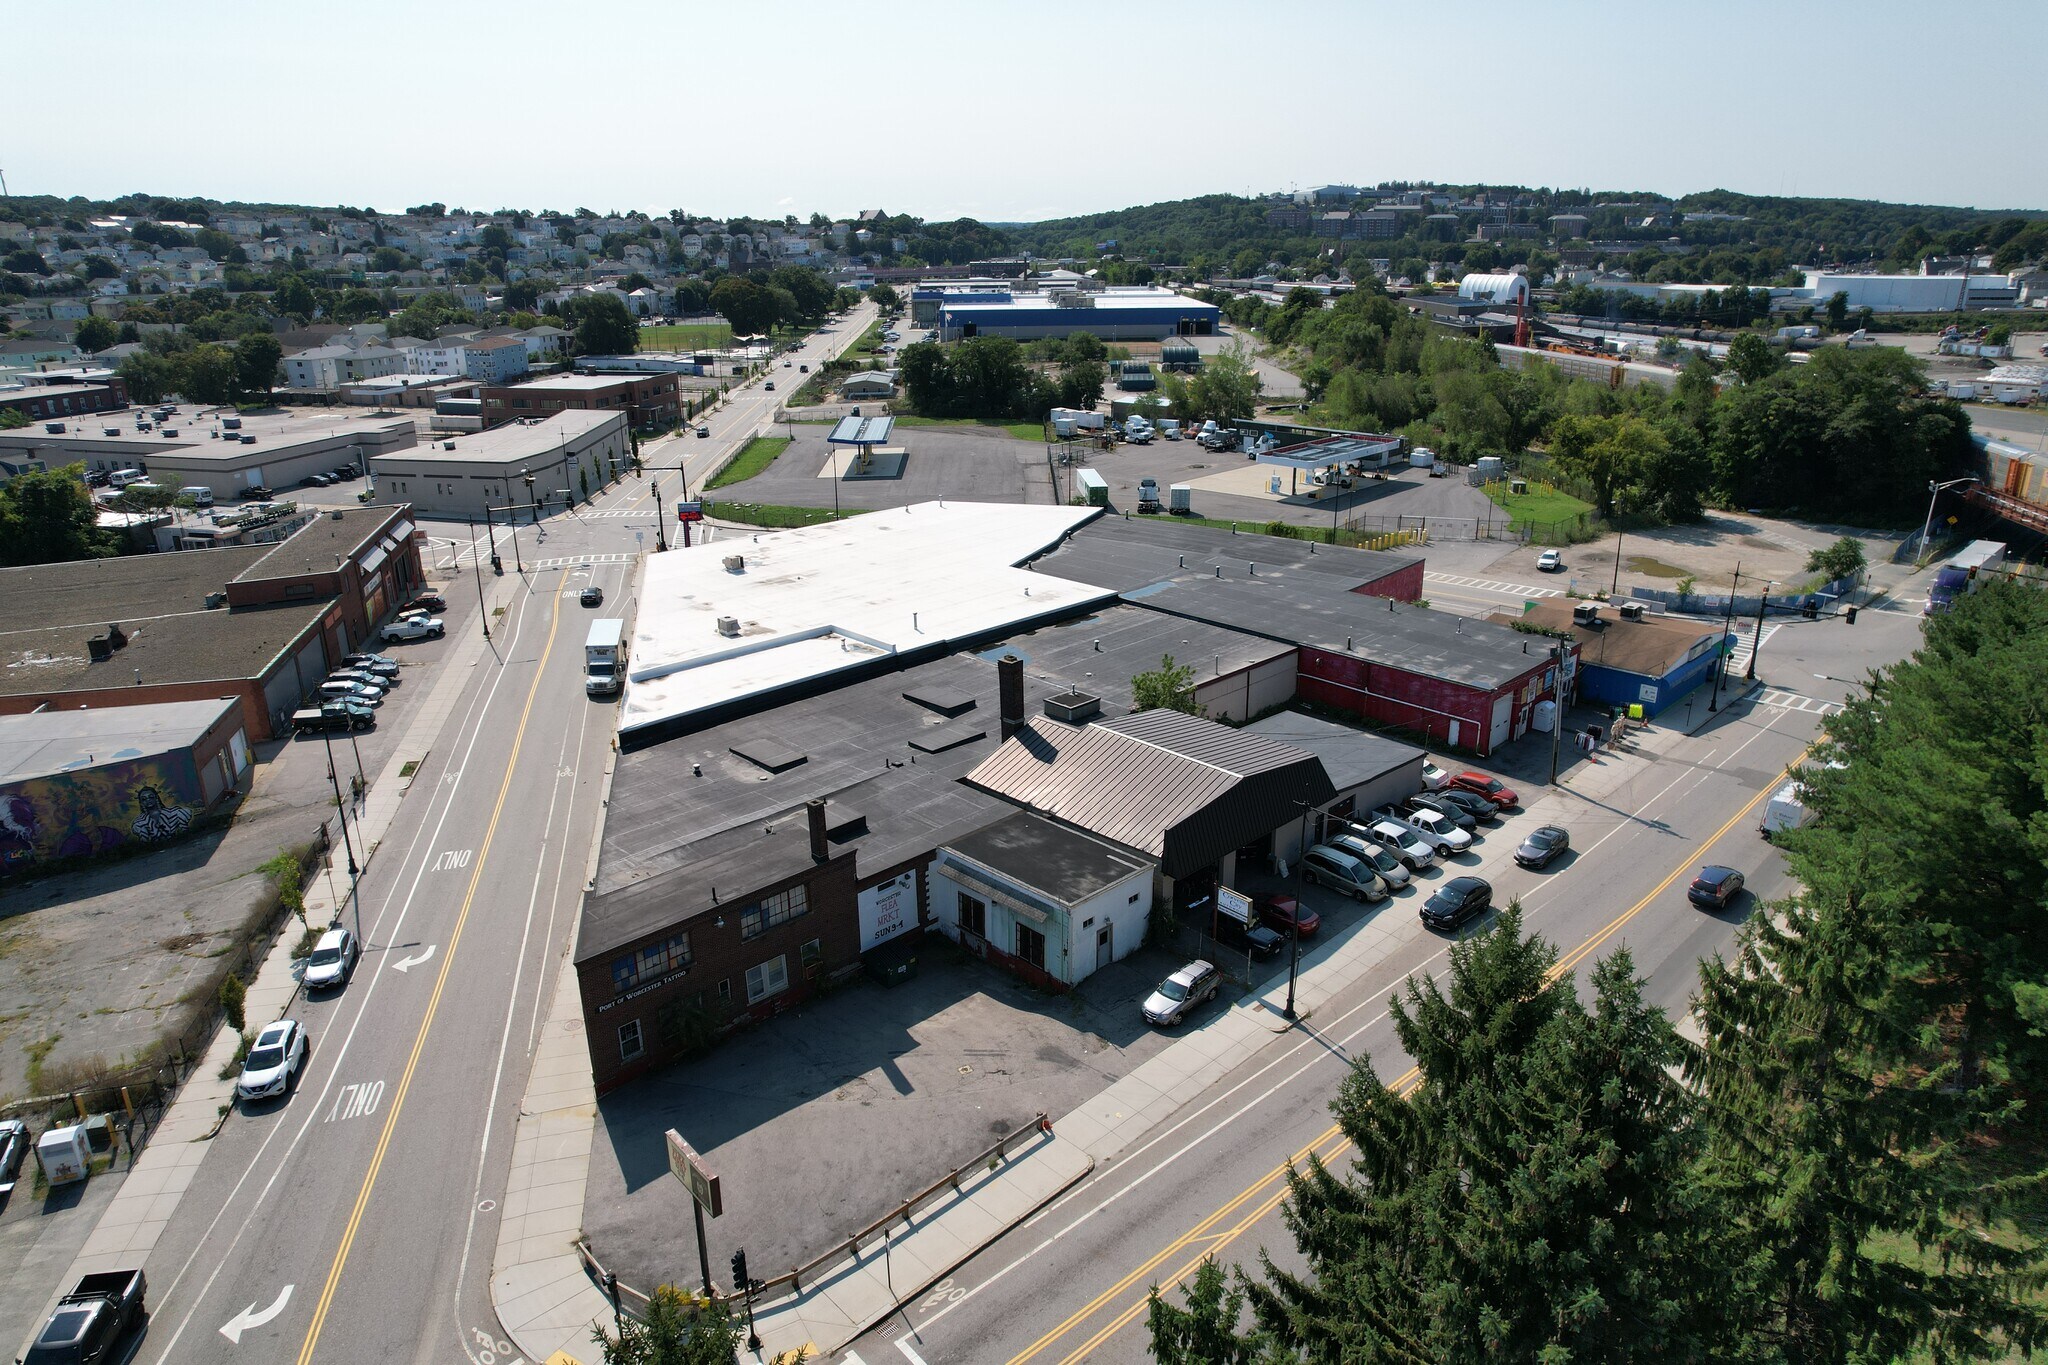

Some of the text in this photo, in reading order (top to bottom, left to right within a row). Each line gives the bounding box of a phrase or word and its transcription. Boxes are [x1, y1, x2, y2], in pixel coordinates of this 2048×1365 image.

[430, 849, 472, 873] ONLY
[875, 890, 902, 906] WORCESTER
[880, 899, 898, 913] FLEA
[598, 1001, 616, 1013] PORT
[625, 981, 662, 1000] WORCESTER
[662, 970, 687, 984] TATTOO
[324, 1080, 386, 1124] ONLY
